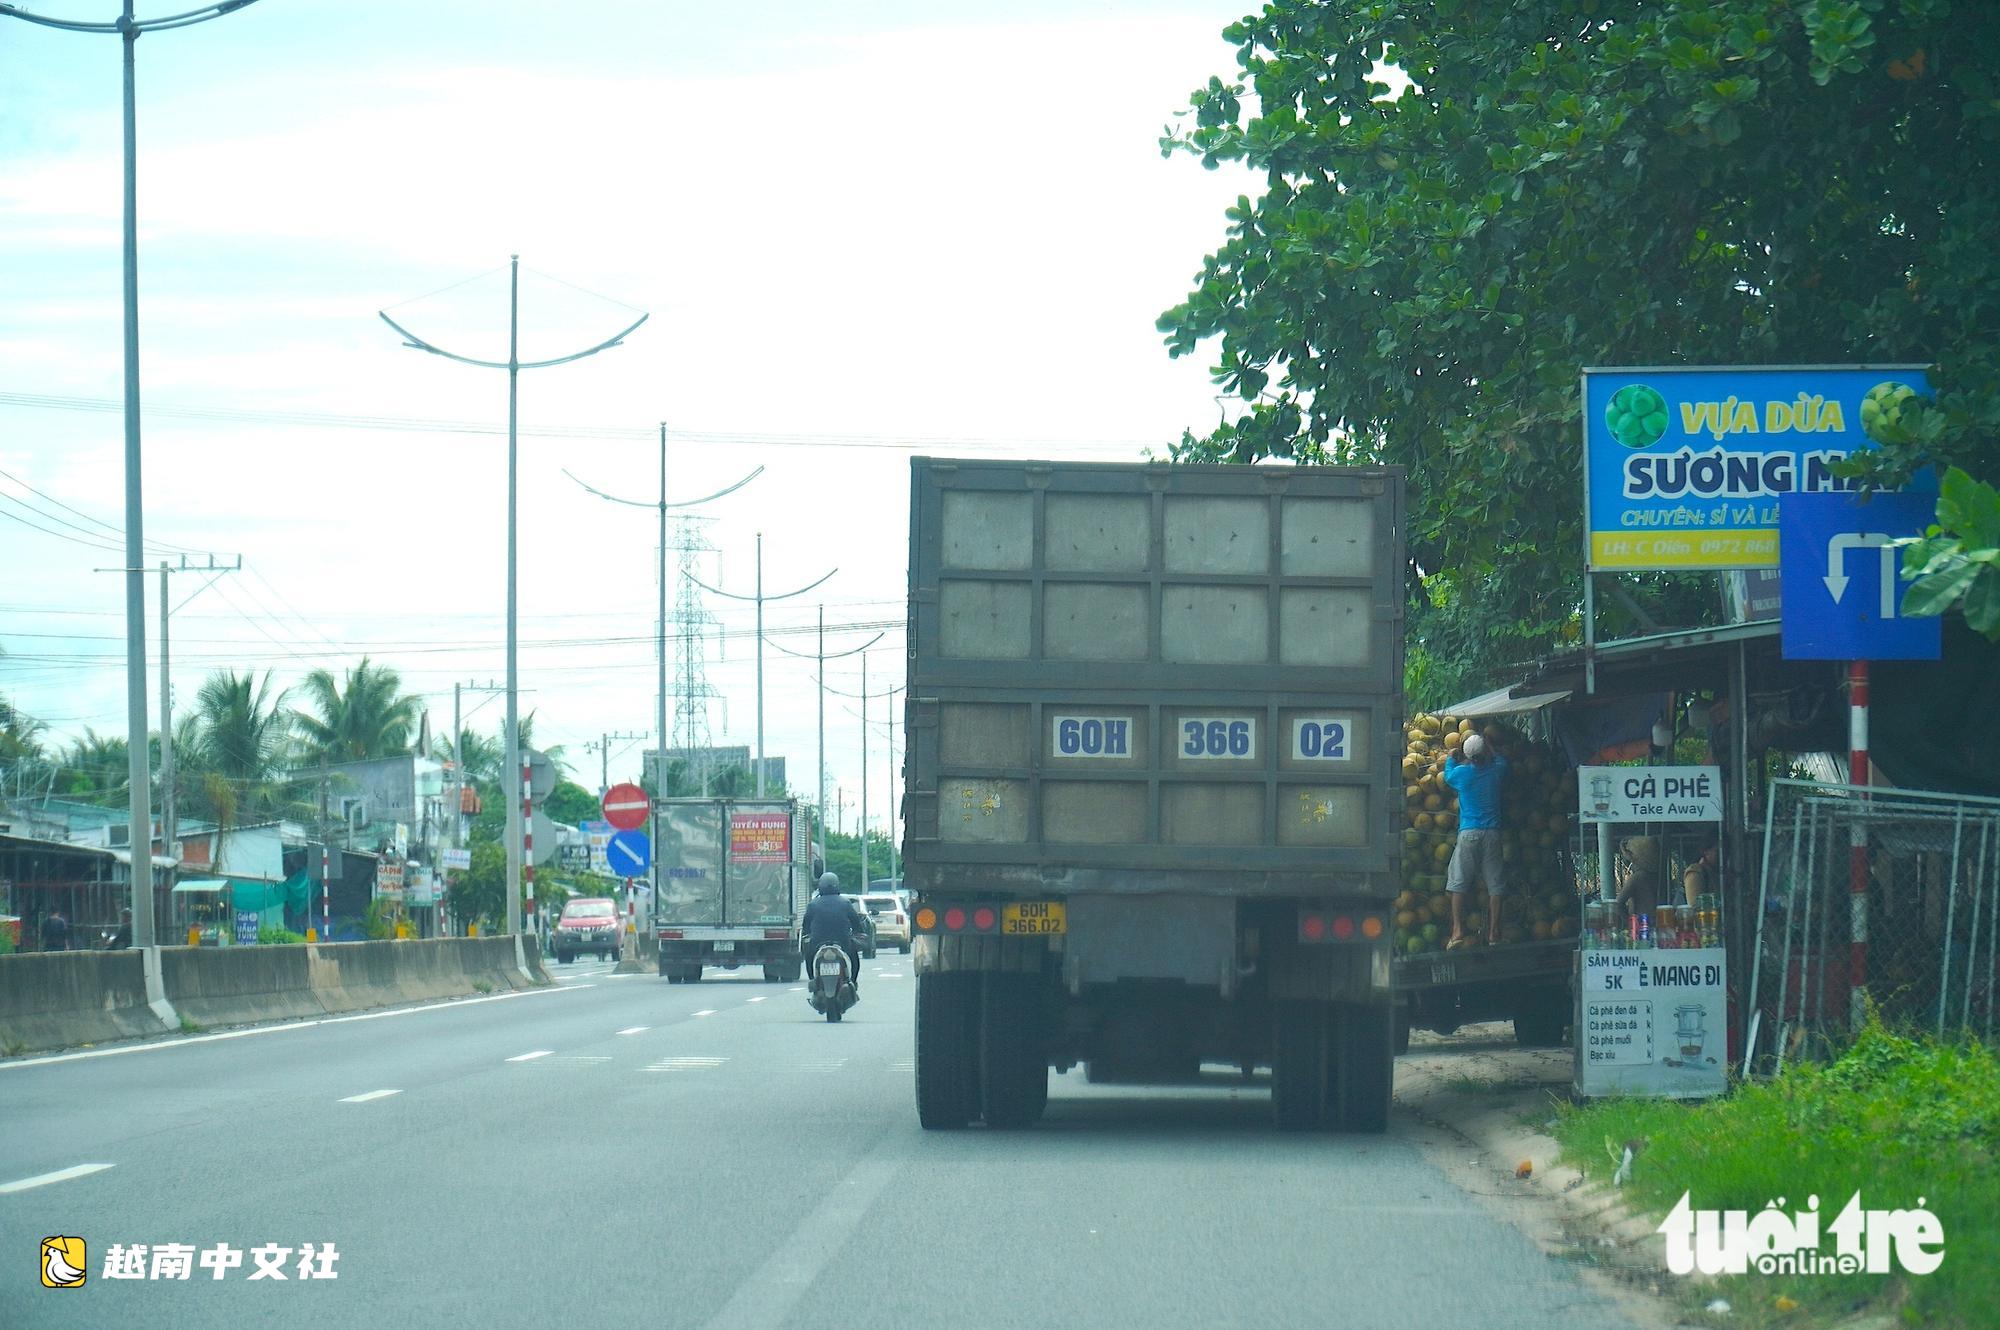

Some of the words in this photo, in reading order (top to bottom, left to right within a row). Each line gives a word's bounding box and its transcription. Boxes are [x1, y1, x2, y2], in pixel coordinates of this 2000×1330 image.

[1681, 396, 1758, 440] VỰA
[1766, 392, 1845, 432] DỪA
[1626, 449, 1794, 496] SƯƠNG
[1621, 506, 1706, 526] CHUYÊN:
[1732, 505, 1756, 525] VÀ
[1060, 719, 1127, 755] 60H
[1184, 721, 1249, 756] 366
[1300, 723, 1345, 757] 02
[1624, 773, 1656, 799] CÀ
[1664, 773, 1711, 799] PHÊ
[1631, 803, 1663, 815] Take
[1667, 803, 1705, 817] Away
[1020, 903, 1049, 918] 60H
[1009, 919, 1060, 933] 366.02
[1588, 953, 1609, 967] SÂM
[1612, 956, 1639, 969] LẠNH
[1605, 975, 1623, 989] 5K
[1653, 966, 1700, 986] MANG
[1705, 965, 1720, 986] ĐI
